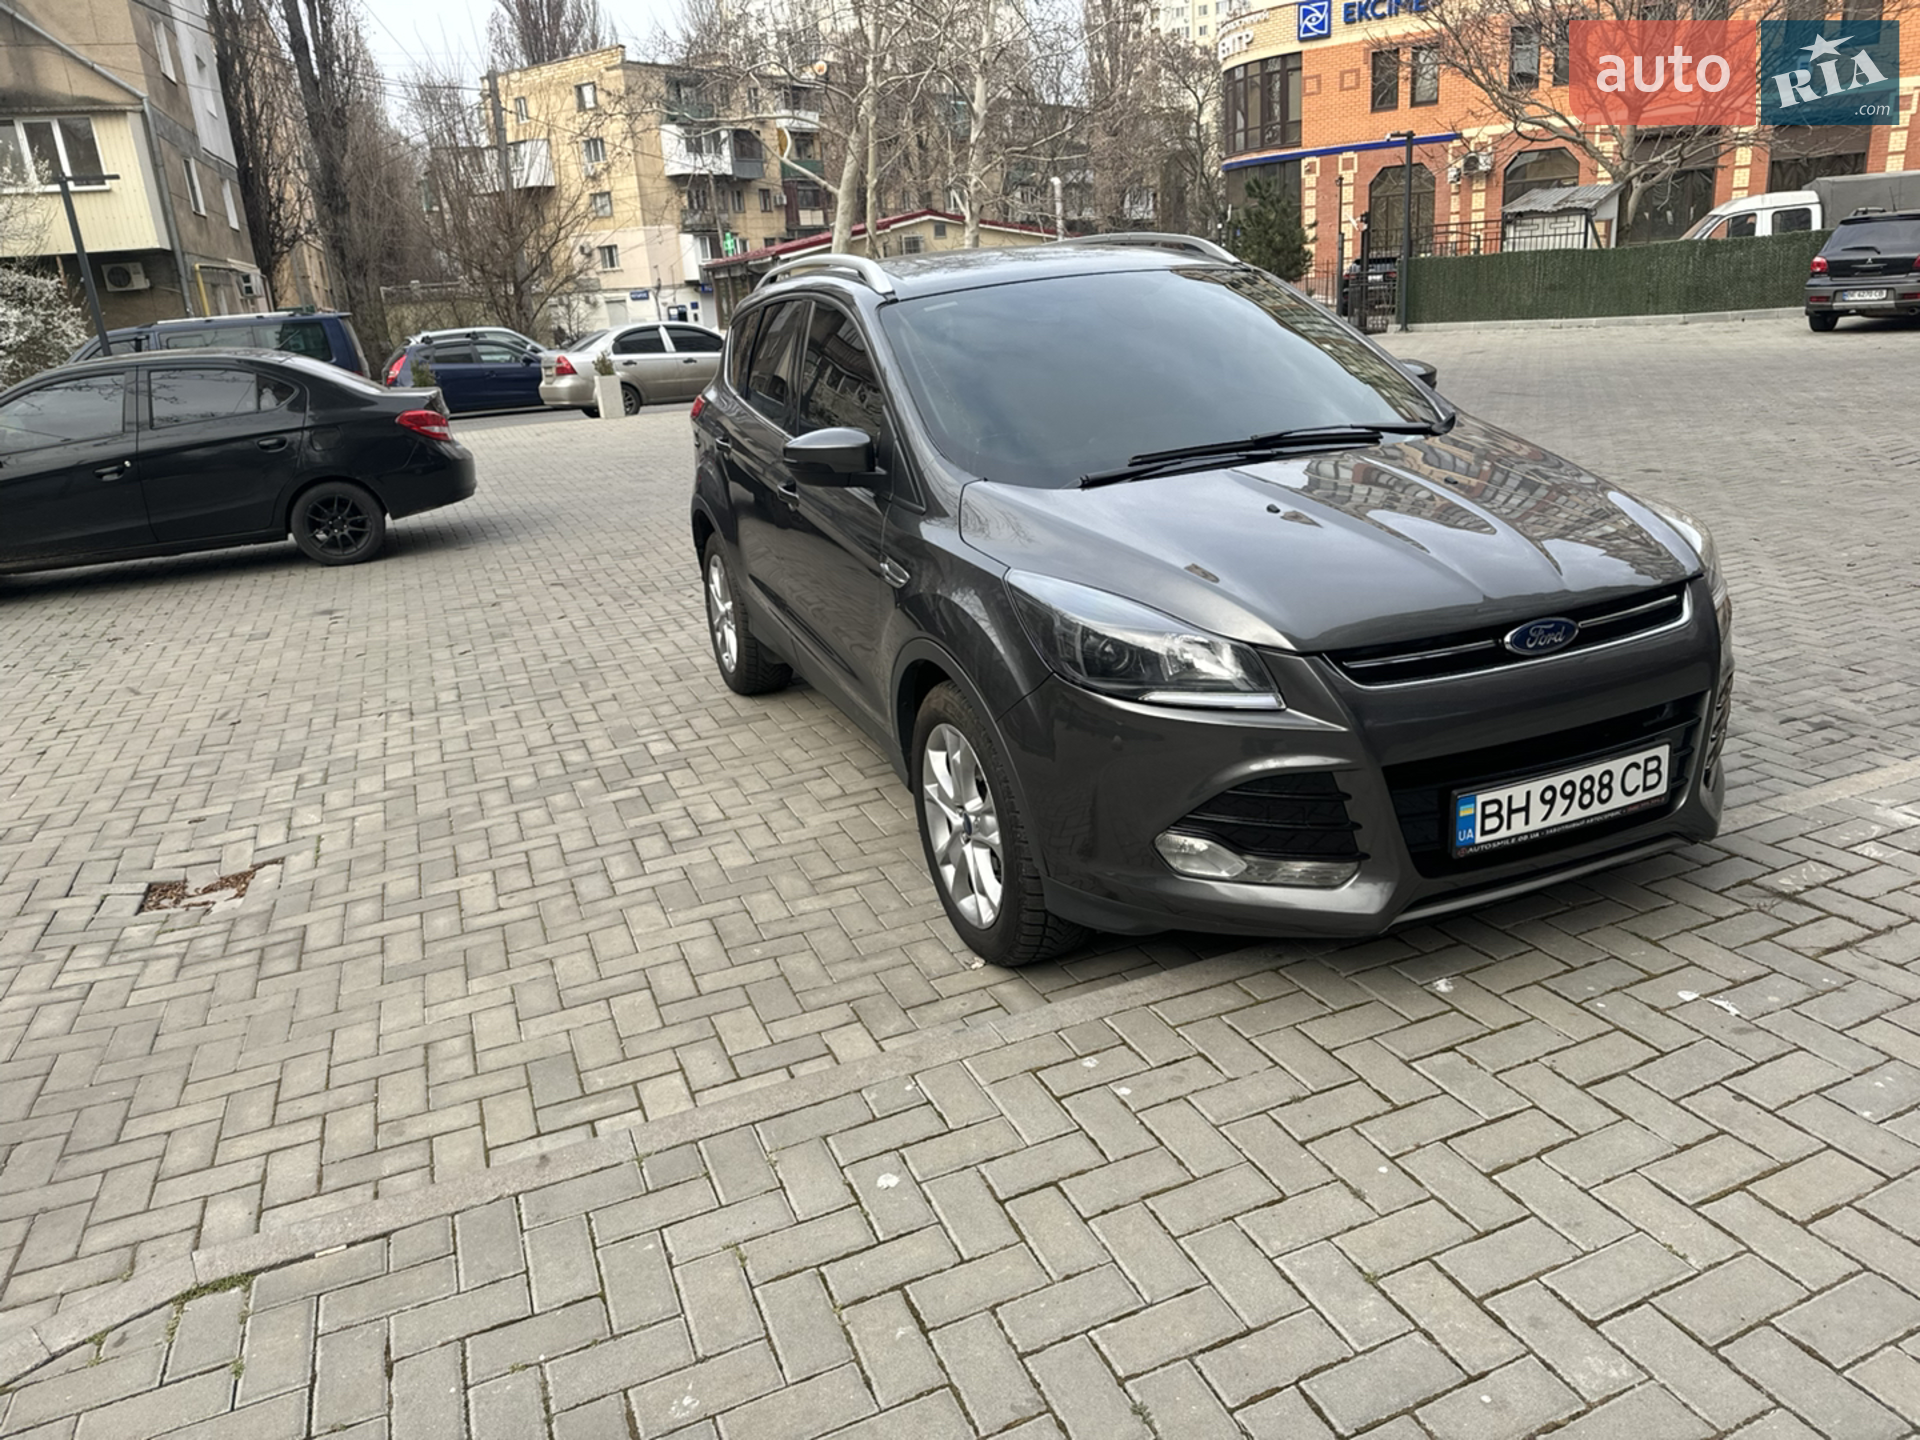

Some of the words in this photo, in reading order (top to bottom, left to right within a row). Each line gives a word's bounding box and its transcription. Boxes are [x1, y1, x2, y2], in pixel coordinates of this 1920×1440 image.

[1342, 0, 1431, 23] ЕКСІМЕ
[1526, 623, 1566, 648] Ford
[1479, 789, 1532, 838] BH
[1539, 768, 1615, 822] 9988
[1620, 754, 1663, 798] CB
[1458, 828, 1474, 842] UA
